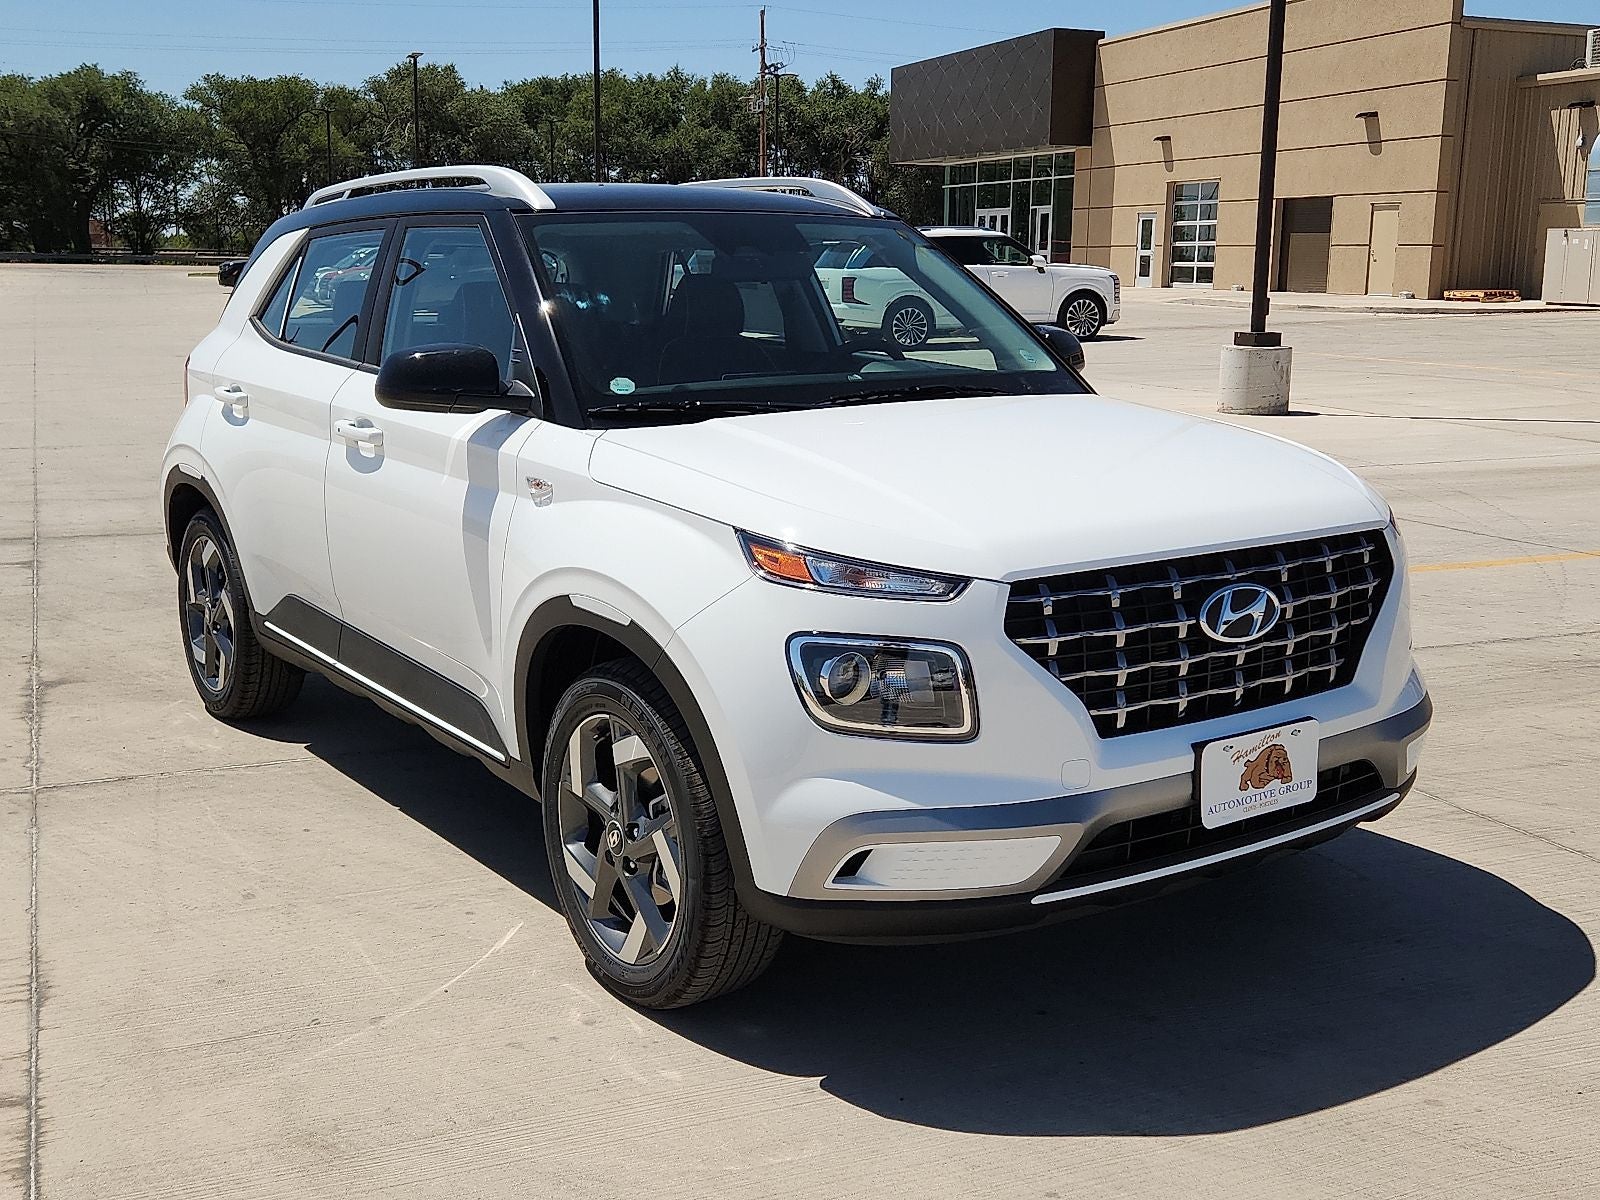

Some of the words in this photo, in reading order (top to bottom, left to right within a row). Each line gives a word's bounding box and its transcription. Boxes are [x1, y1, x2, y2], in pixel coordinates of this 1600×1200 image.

[1231, 730, 1281, 765] Hamilton
[1207, 787, 1276, 815] AUTOMOTIVE
[1278, 779, 1313, 796] GROUP
